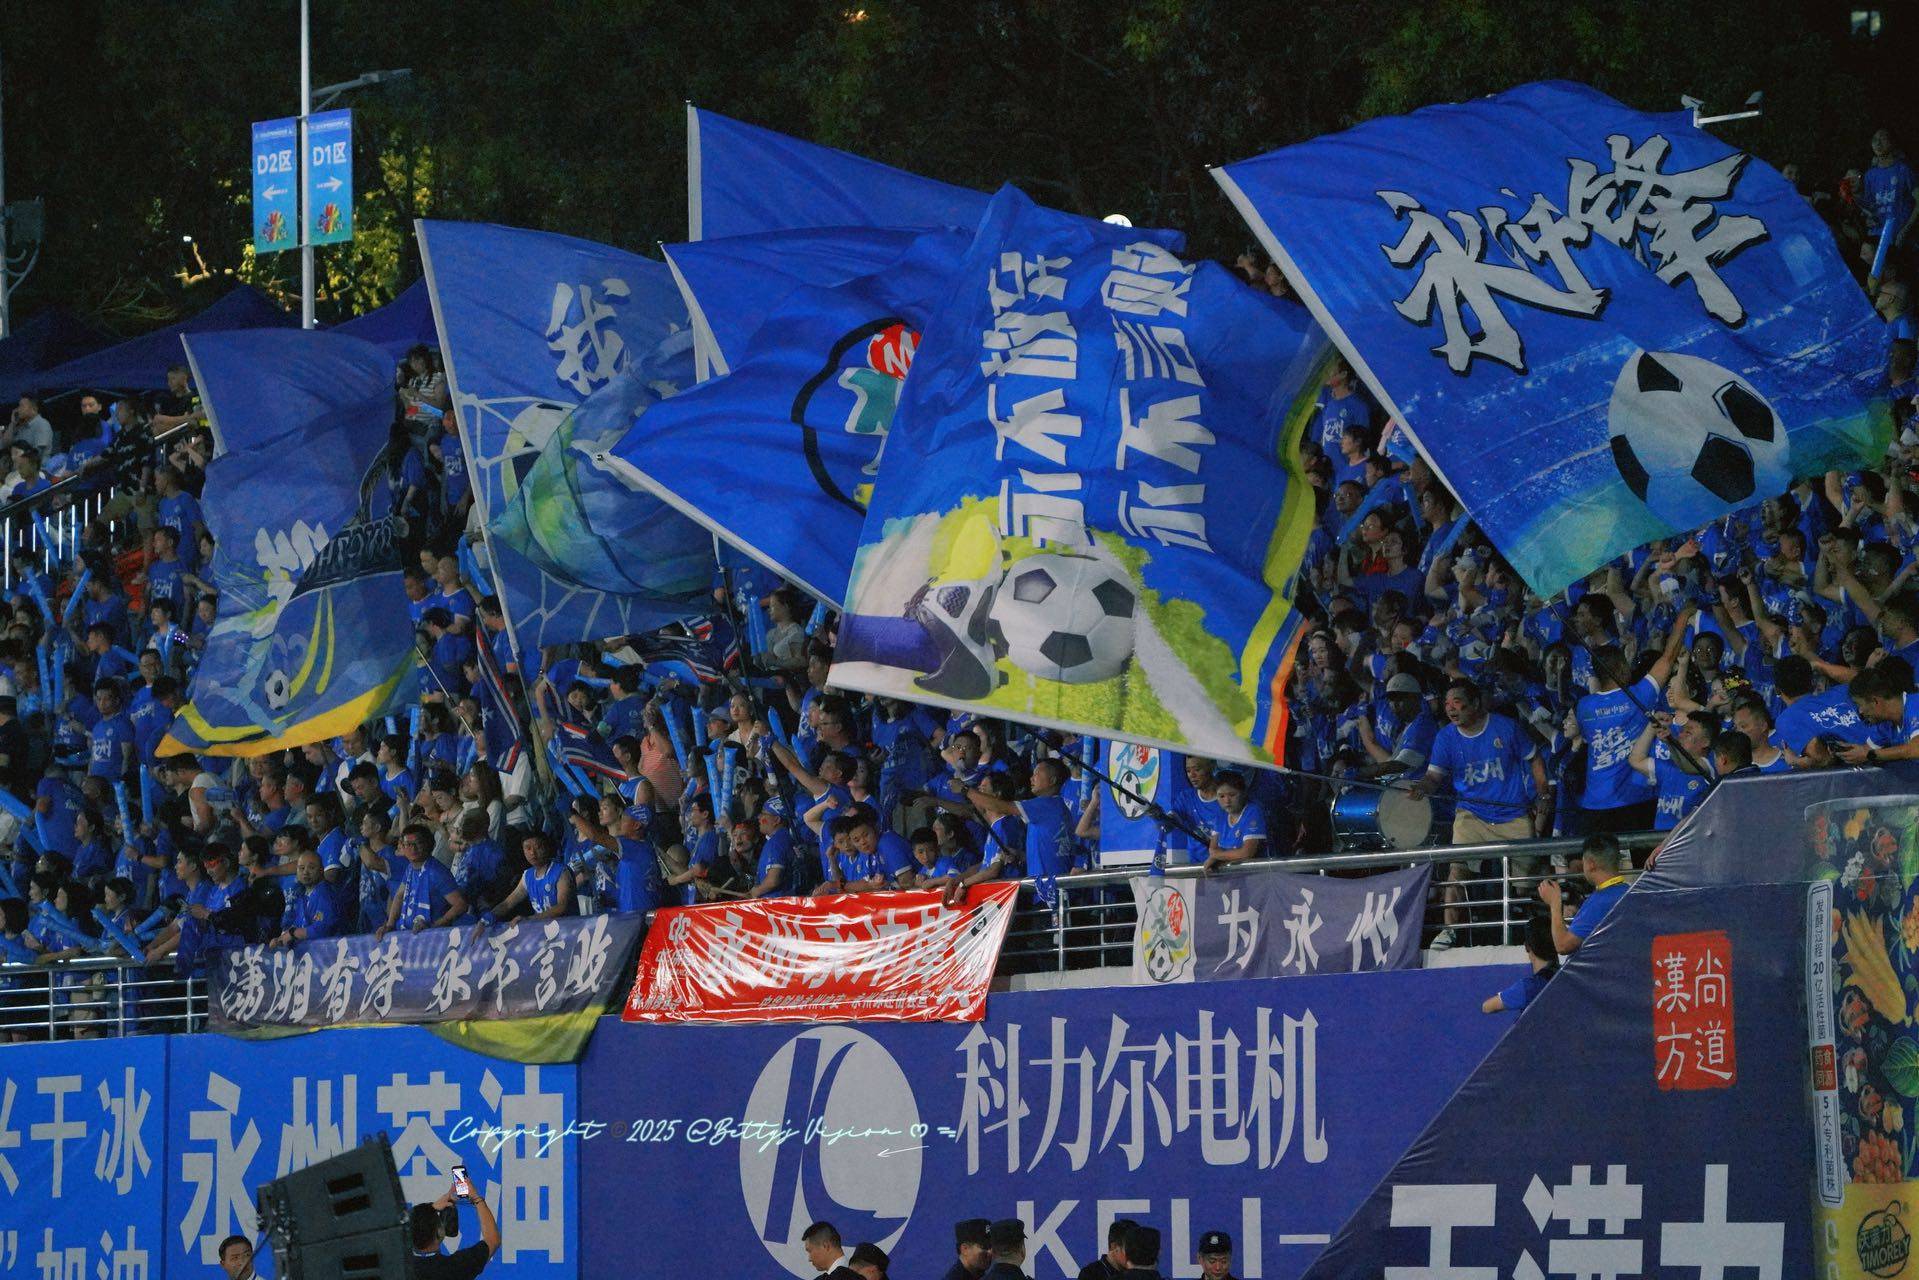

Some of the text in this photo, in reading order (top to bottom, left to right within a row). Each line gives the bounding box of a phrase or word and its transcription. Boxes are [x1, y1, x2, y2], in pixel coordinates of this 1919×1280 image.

[256, 149, 293, 175] D2区
[312, 141, 347, 166] D1区
[980, 250, 1083, 550] 永不放弃
[1100, 241, 1217, 554] 永不言败
[1654, 951, 1693, 1082] 漢方
[1695, 948, 1733, 1081] 尚道
[954, 1006, 1329, 1177] 科力尔电机
